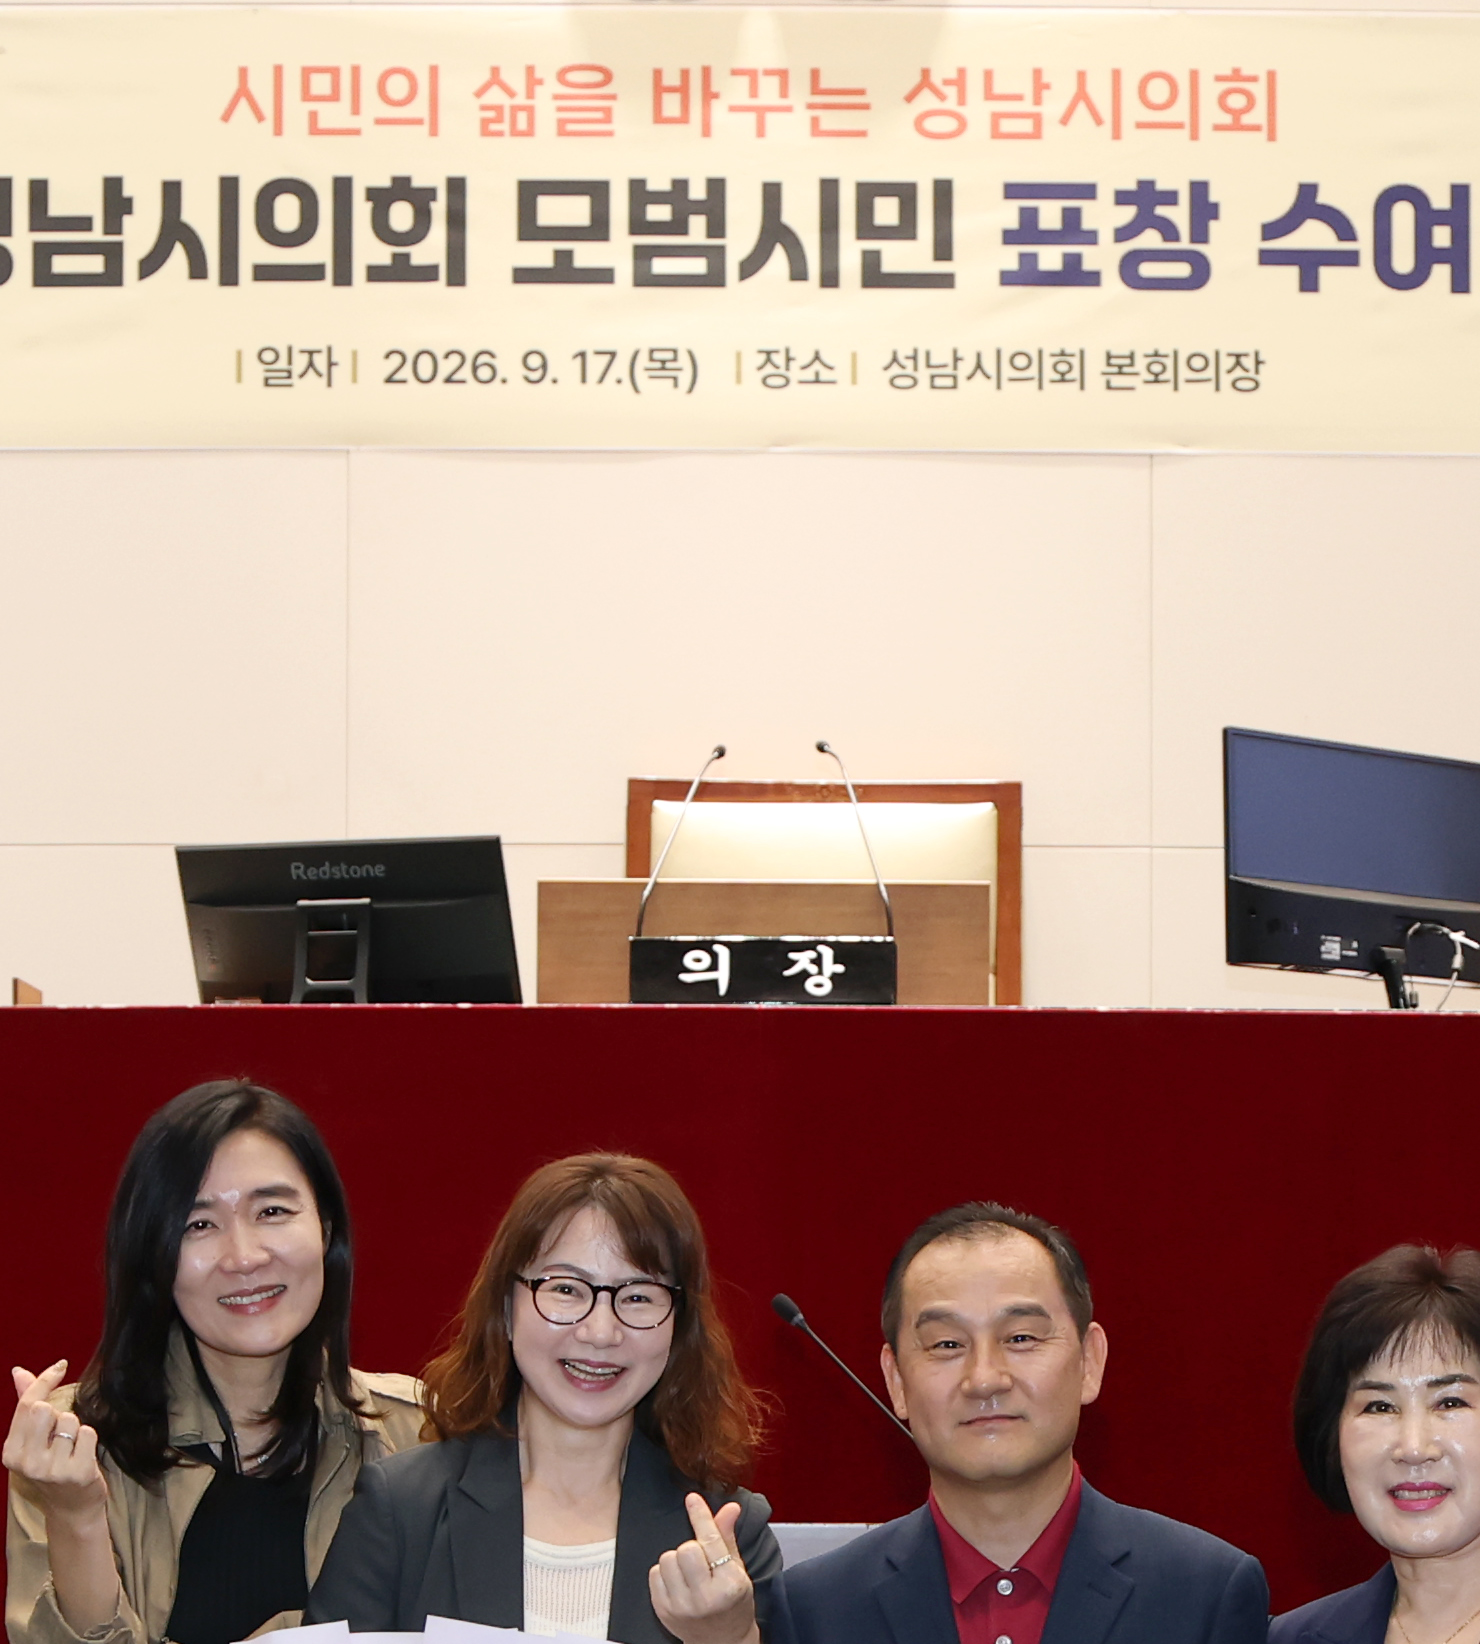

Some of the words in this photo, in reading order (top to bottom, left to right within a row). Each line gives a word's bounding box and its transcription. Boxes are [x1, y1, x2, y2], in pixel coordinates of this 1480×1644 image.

[220, 64, 439, 138] 시민의
[473, 64, 618, 138] 삶을
[652, 66, 872, 138] 바꾸는
[902, 67, 1278, 142] 성남시의회
[512, 177, 956, 290] 모범시민
[998, 180, 1220, 291] 표창
[257, 345, 339, 388] 일자
[383, 349, 508, 385] 2026.
[521, 349, 558, 385] 9.
[572, 347, 698, 394] 17.(목)
[756, 347, 837, 390] 장소
[883, 348, 1086, 391] 성남시의회
[1101, 349, 1266, 393] 본회의장
[290, 861, 386, 881] Redstone
